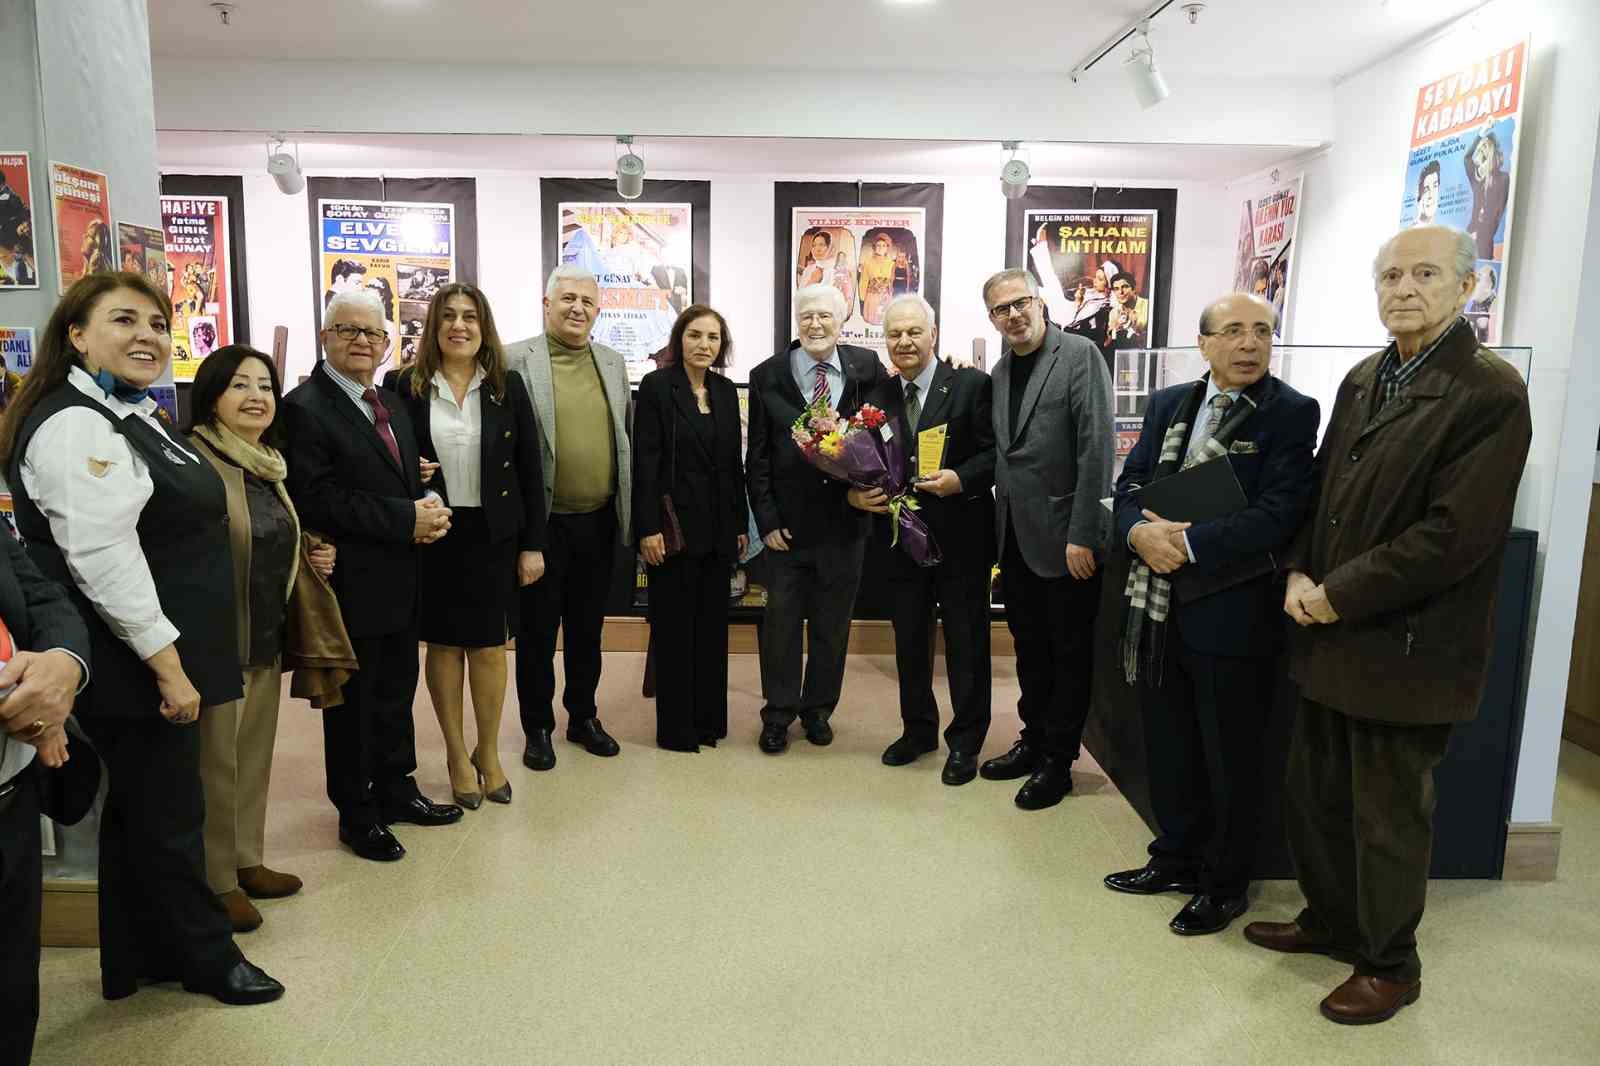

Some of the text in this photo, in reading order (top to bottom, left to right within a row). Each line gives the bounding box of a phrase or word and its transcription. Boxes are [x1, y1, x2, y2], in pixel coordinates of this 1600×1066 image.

[1415, 82, 1513, 139] KABADAYI
[162, 201, 215, 215] HAFİYE
[1058, 226, 1147, 238] ŞAHANE
